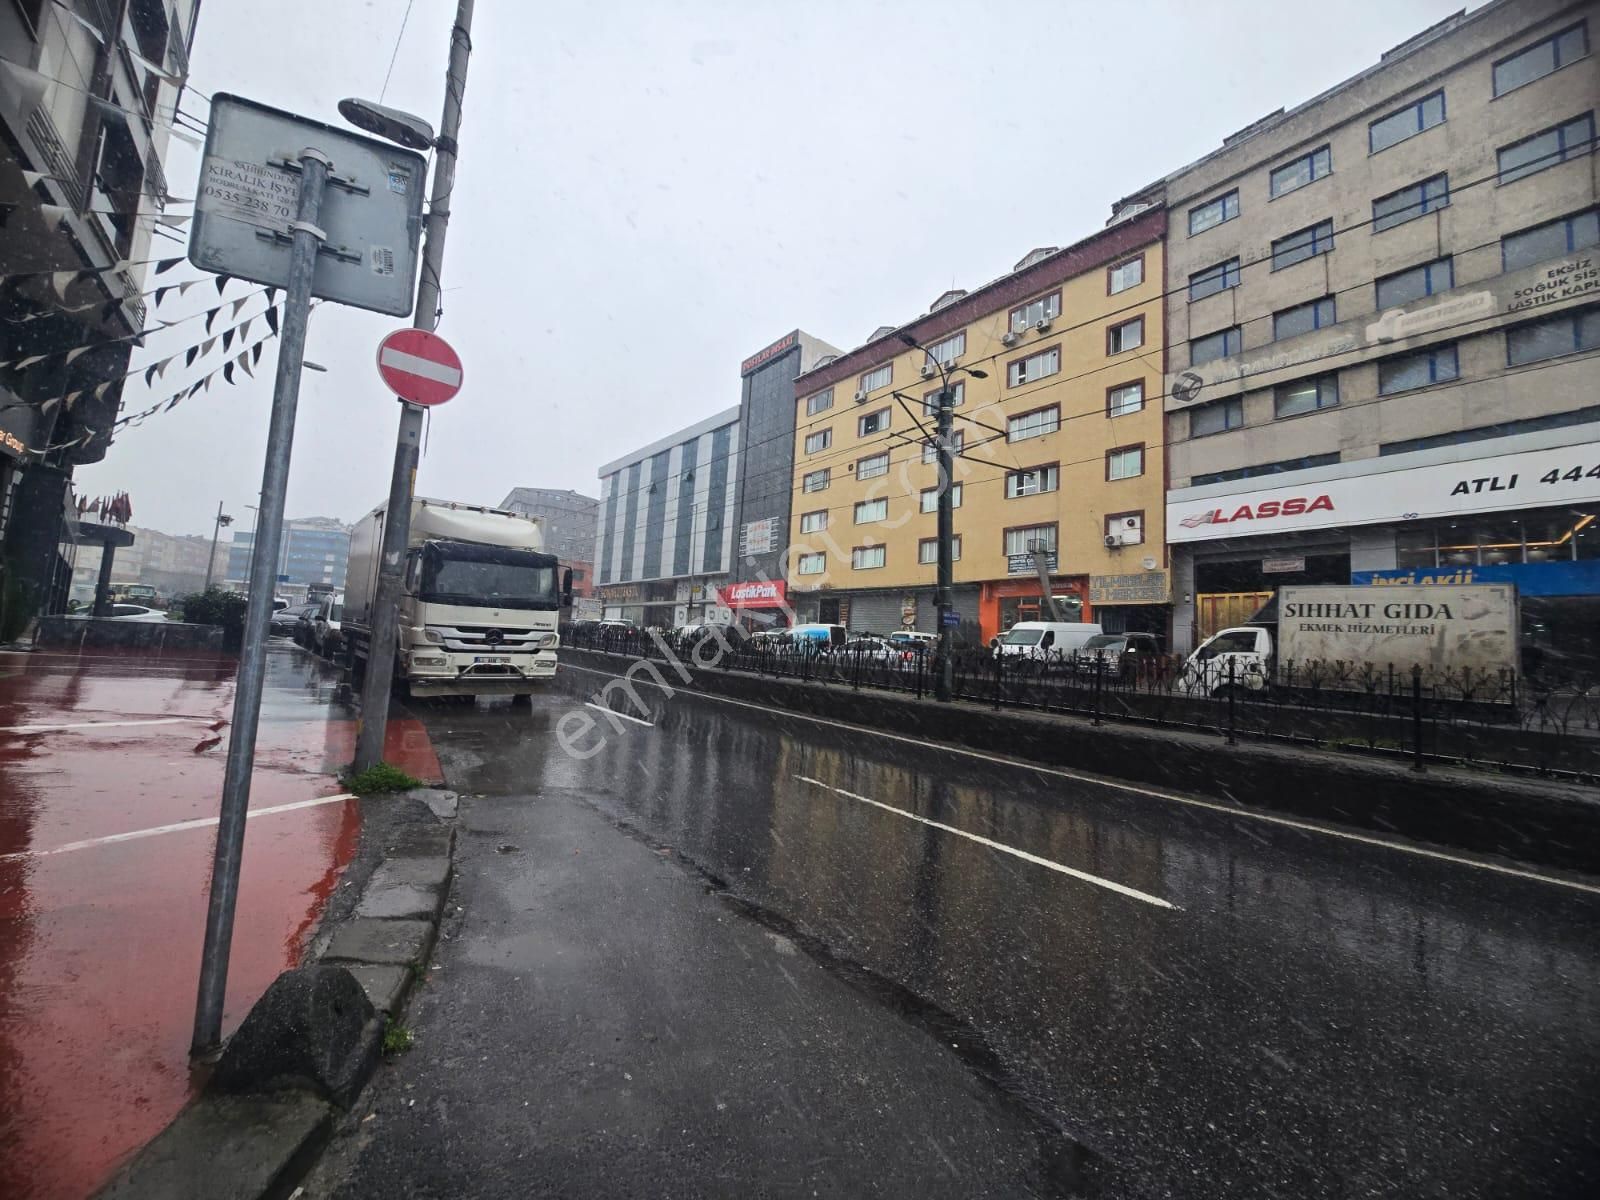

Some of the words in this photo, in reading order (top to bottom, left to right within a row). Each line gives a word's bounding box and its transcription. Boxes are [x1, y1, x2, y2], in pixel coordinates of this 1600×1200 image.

[209, 165, 265, 188] KİRALIK
[205, 186, 240, 203] 0535
[243, 196, 269, 212] 238
[273, 204, 290, 217] 70
[1547, 258, 1592, 278] EKSİZ
[1514, 276, 1569, 299] SOĞUK
[1574, 267, 1600, 282] SİS
[1507, 290, 1558, 311] LASTİK
[6, 432, 24, 454] Group
[1450, 474, 1519, 496] ATLI
[1540, 464, 1600, 485] 444
[1211, 494, 1334, 524] LASSA
[1284, 602, 1375, 619] SIHHAT
[1383, 602, 1453, 620] GIDA
[1299, 622, 1343, 634] EKMEK
[1347, 622, 1435, 636] HİZMETLERİ
